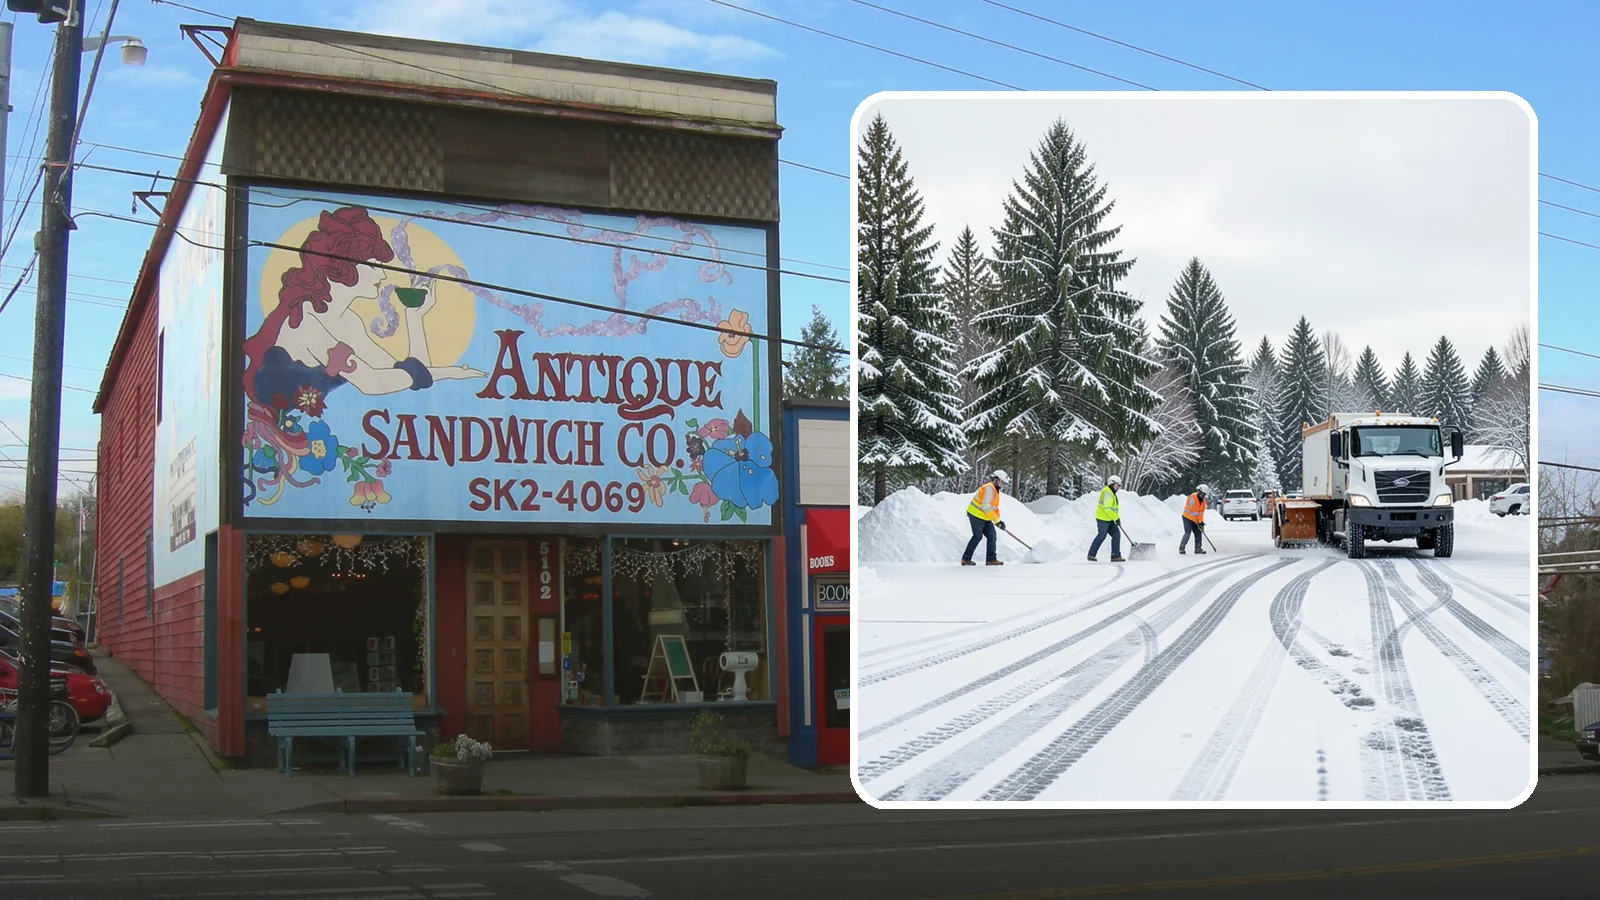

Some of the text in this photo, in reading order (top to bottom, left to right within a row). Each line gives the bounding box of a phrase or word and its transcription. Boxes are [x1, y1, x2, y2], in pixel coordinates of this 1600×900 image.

[476, 329, 724, 420] ANTIQUE
[361, 408, 684, 468] SANDWICH CO.
[468, 477, 646, 513] SK2-4069
[539, 542, 551, 599] 5102
[809, 555, 835, 569] BOOKS
